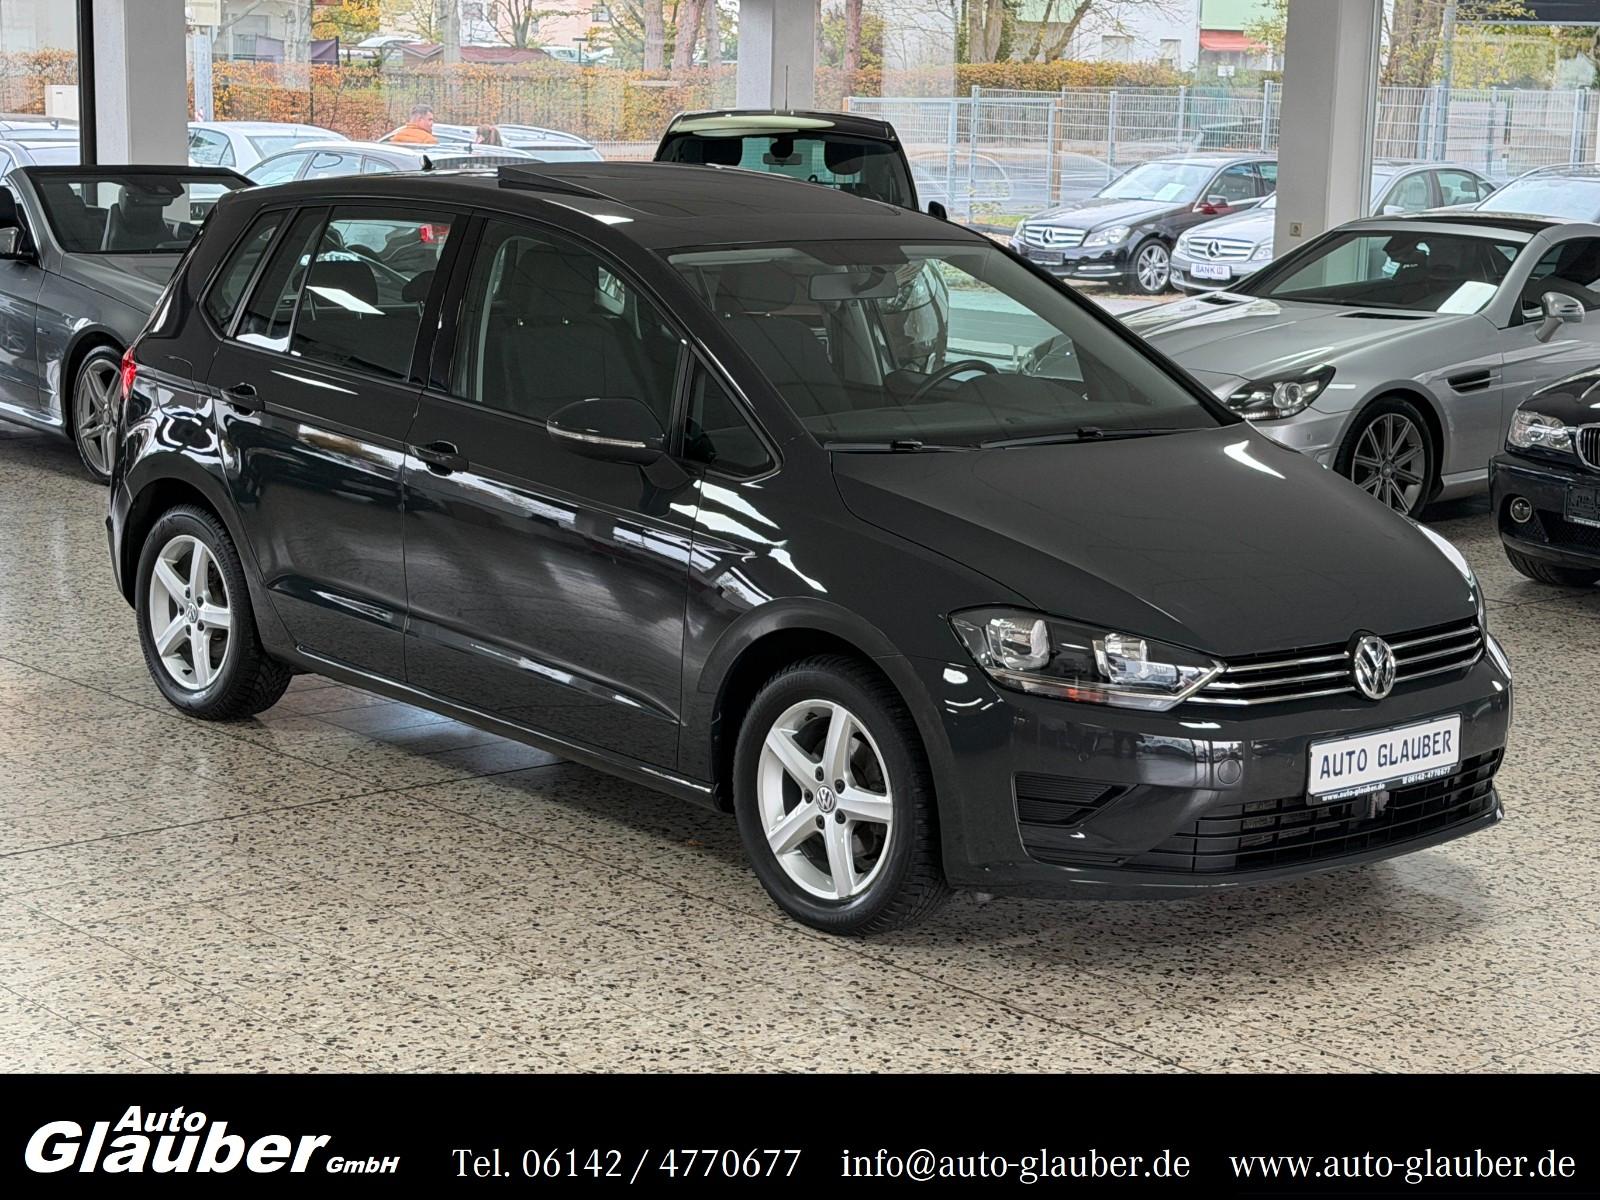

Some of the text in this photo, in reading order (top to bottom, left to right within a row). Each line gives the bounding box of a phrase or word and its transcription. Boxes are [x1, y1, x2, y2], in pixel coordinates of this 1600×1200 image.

[1320, 730, 1452, 780] AUTO GLAUBER
[1322, 783, 1385, 801] www.auto-glauber.de
